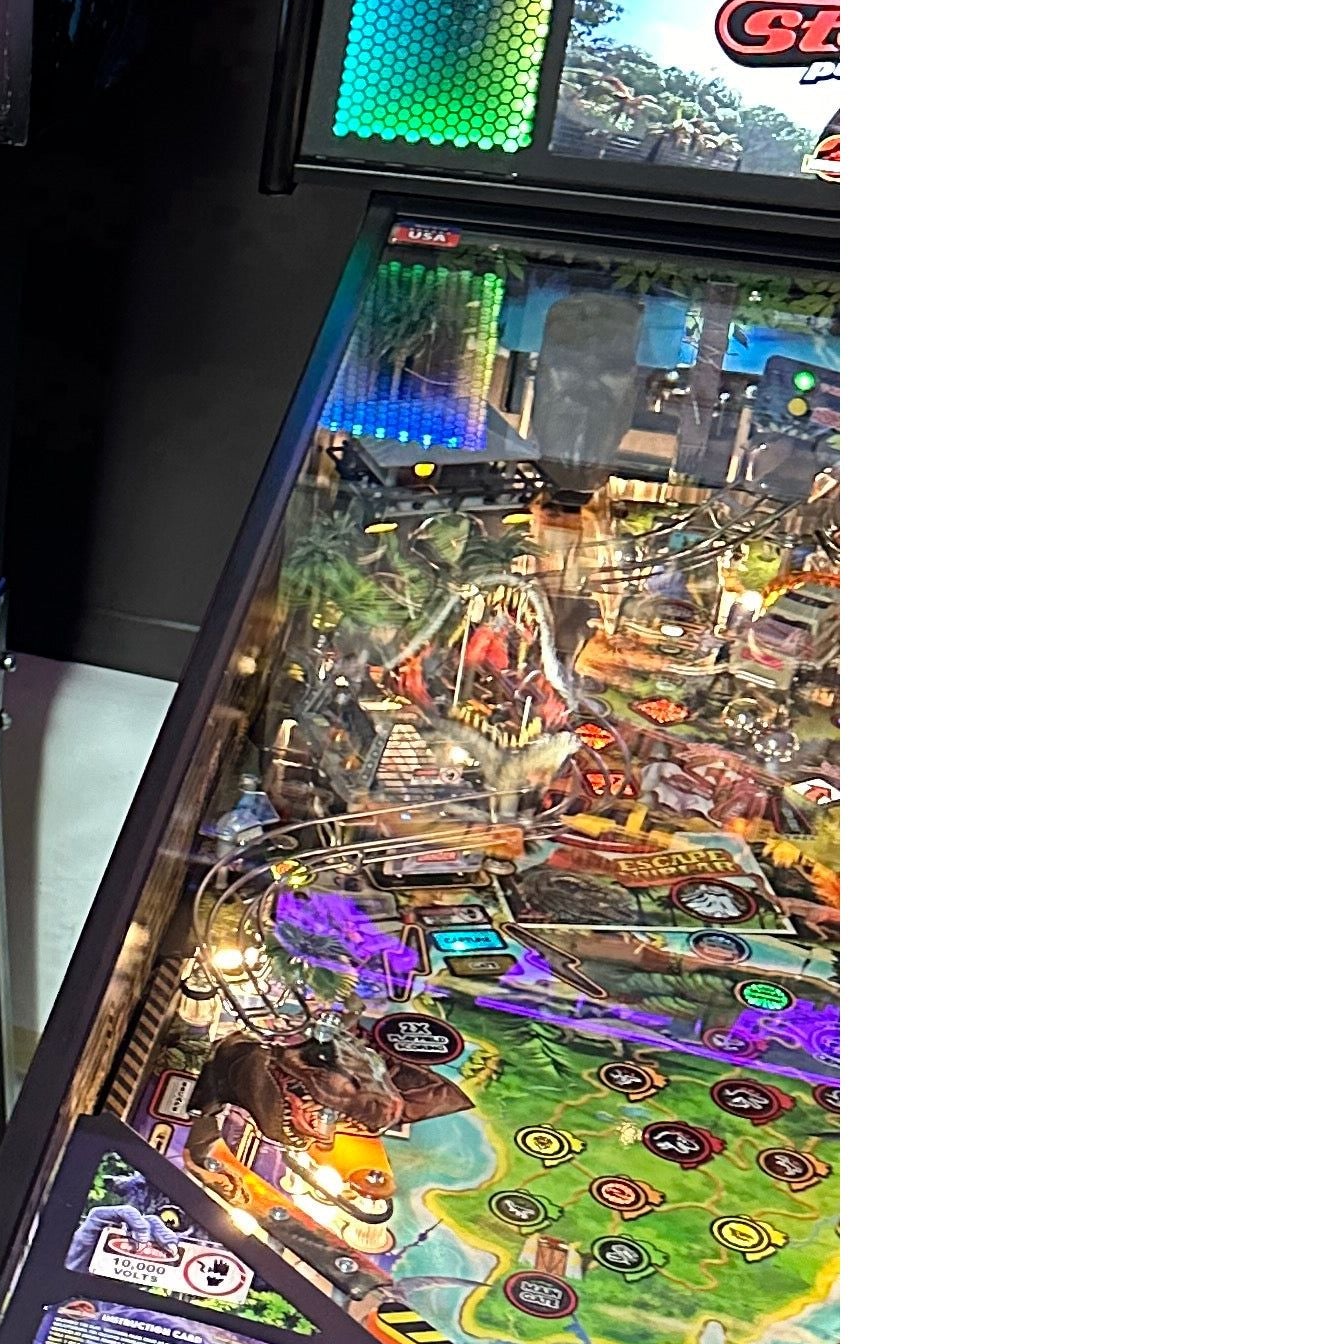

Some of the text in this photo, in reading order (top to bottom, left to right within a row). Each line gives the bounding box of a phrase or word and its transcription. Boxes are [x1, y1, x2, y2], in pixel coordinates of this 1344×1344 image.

[408, 230, 446, 242] USA
[617, 849, 729, 873] ESCAPE
[399, 1022, 432, 1035] 2X
[113, 1257, 167, 1276] 10,000
[113, 1267, 158, 1284] VOLTS
[101, 1313, 204, 1344] INSTRUCTION CARD
